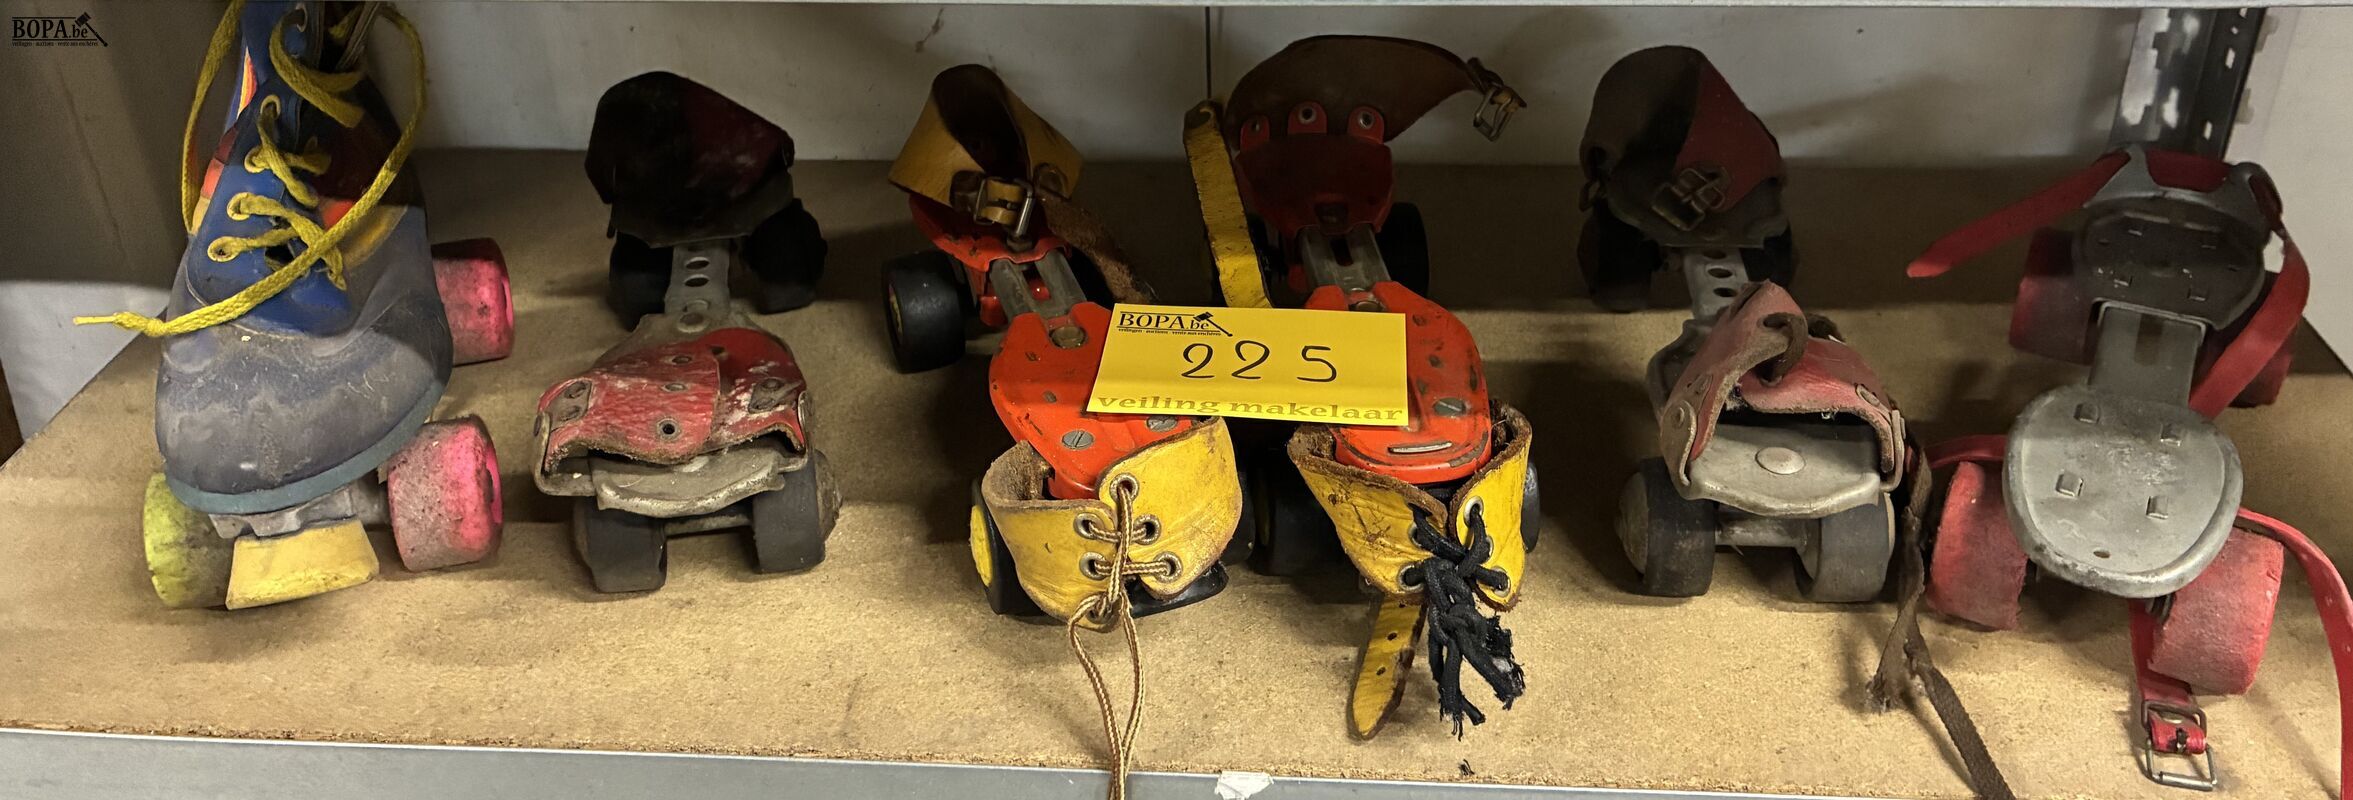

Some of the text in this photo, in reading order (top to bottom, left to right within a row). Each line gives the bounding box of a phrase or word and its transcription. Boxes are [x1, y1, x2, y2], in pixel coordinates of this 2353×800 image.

[1119, 313, 1209, 330] BOPA.be
[1097, 395, 1404, 422] veiling makelaar
